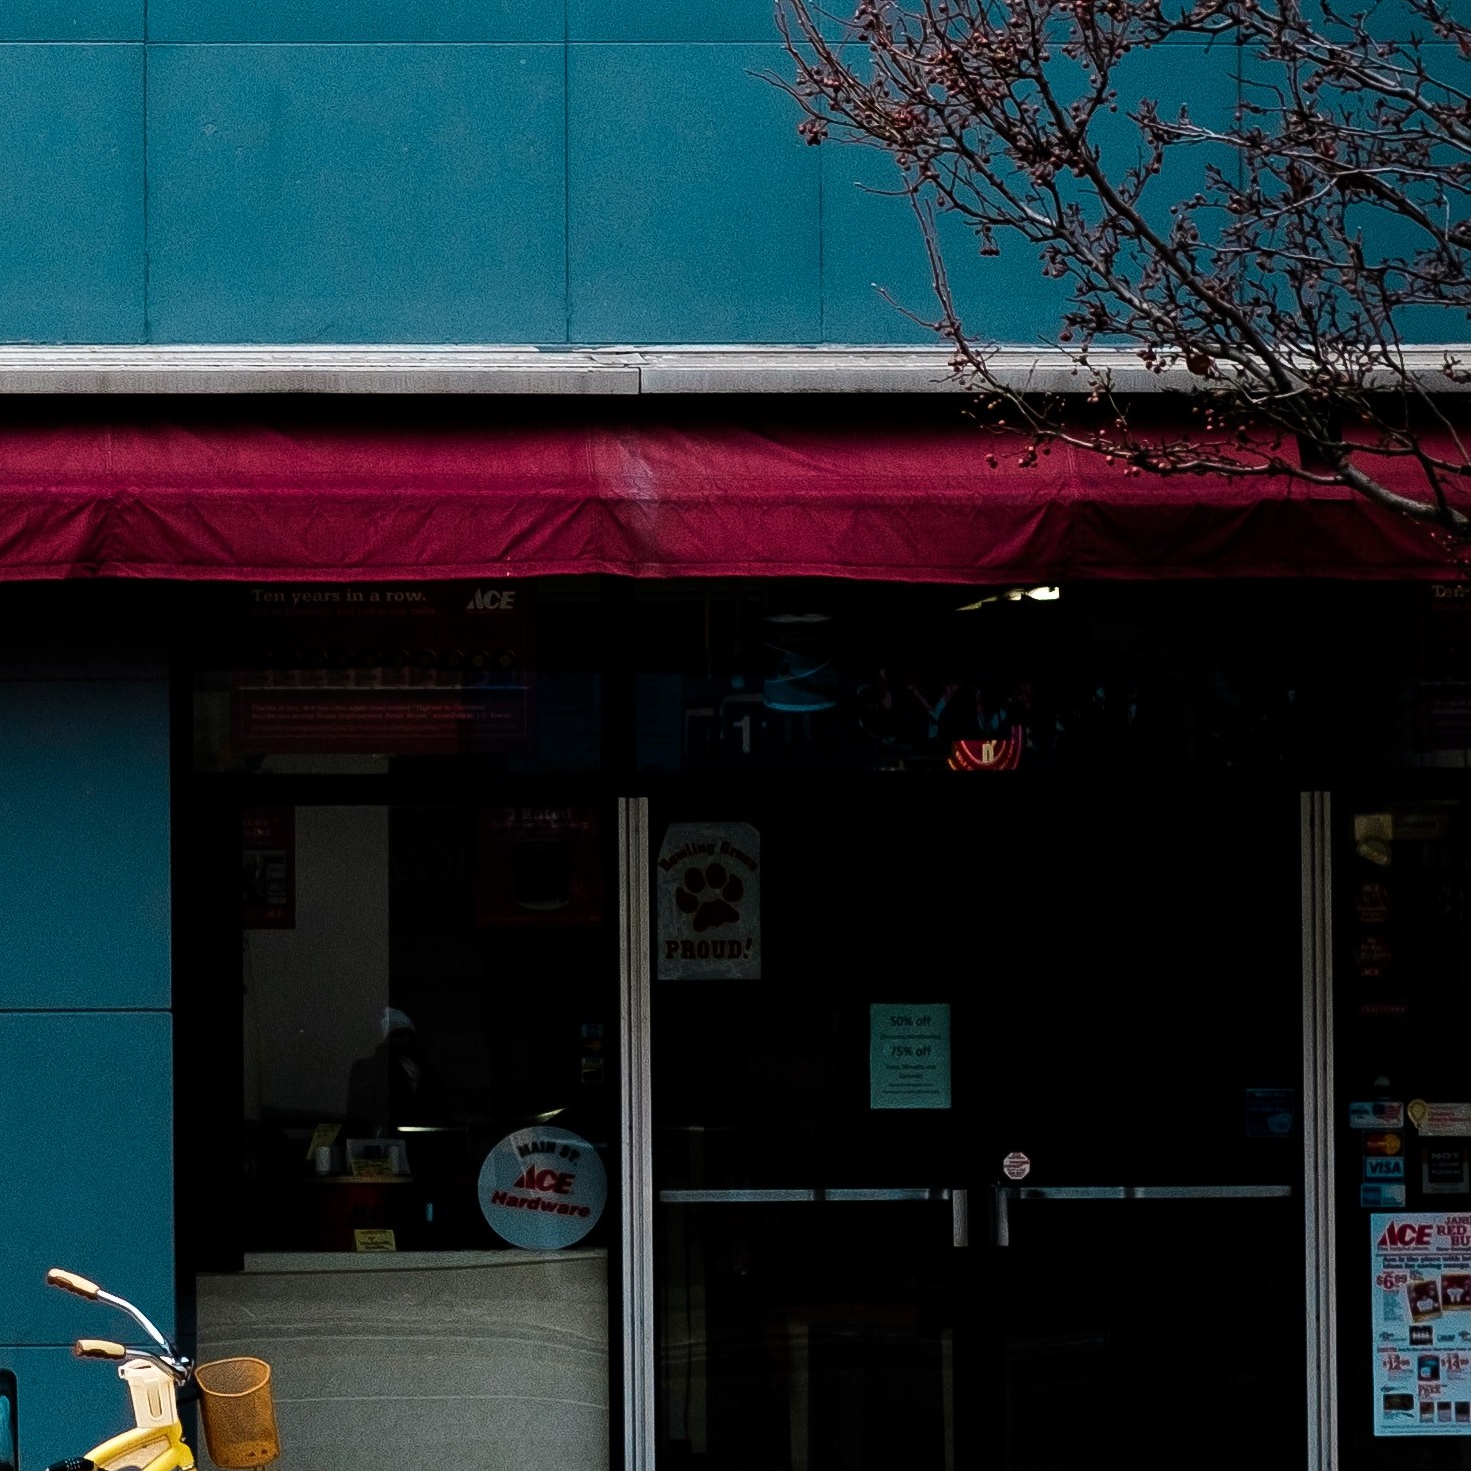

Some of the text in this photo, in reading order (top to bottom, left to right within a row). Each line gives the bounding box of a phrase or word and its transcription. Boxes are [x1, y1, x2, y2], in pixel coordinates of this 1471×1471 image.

[250, 589, 427, 607] Ten years in a row.
[465, 589, 517, 610] ACE
[658, 842, 716, 872] Bowling
[665, 937, 753, 960] PROUD!
[889, 1015, 932, 1027] 50% off
[890, 1045, 932, 1057] 75% off
[516, 1140, 558, 1158] MAIN
[1368, 1161, 1402, 1175] VISA
[513, 1163, 576, 1196] ACE
[490, 1190, 591, 1218] Hardware
[1377, 1220, 1434, 1246] ACE
[1436, 1224, 1468, 1236] RED
